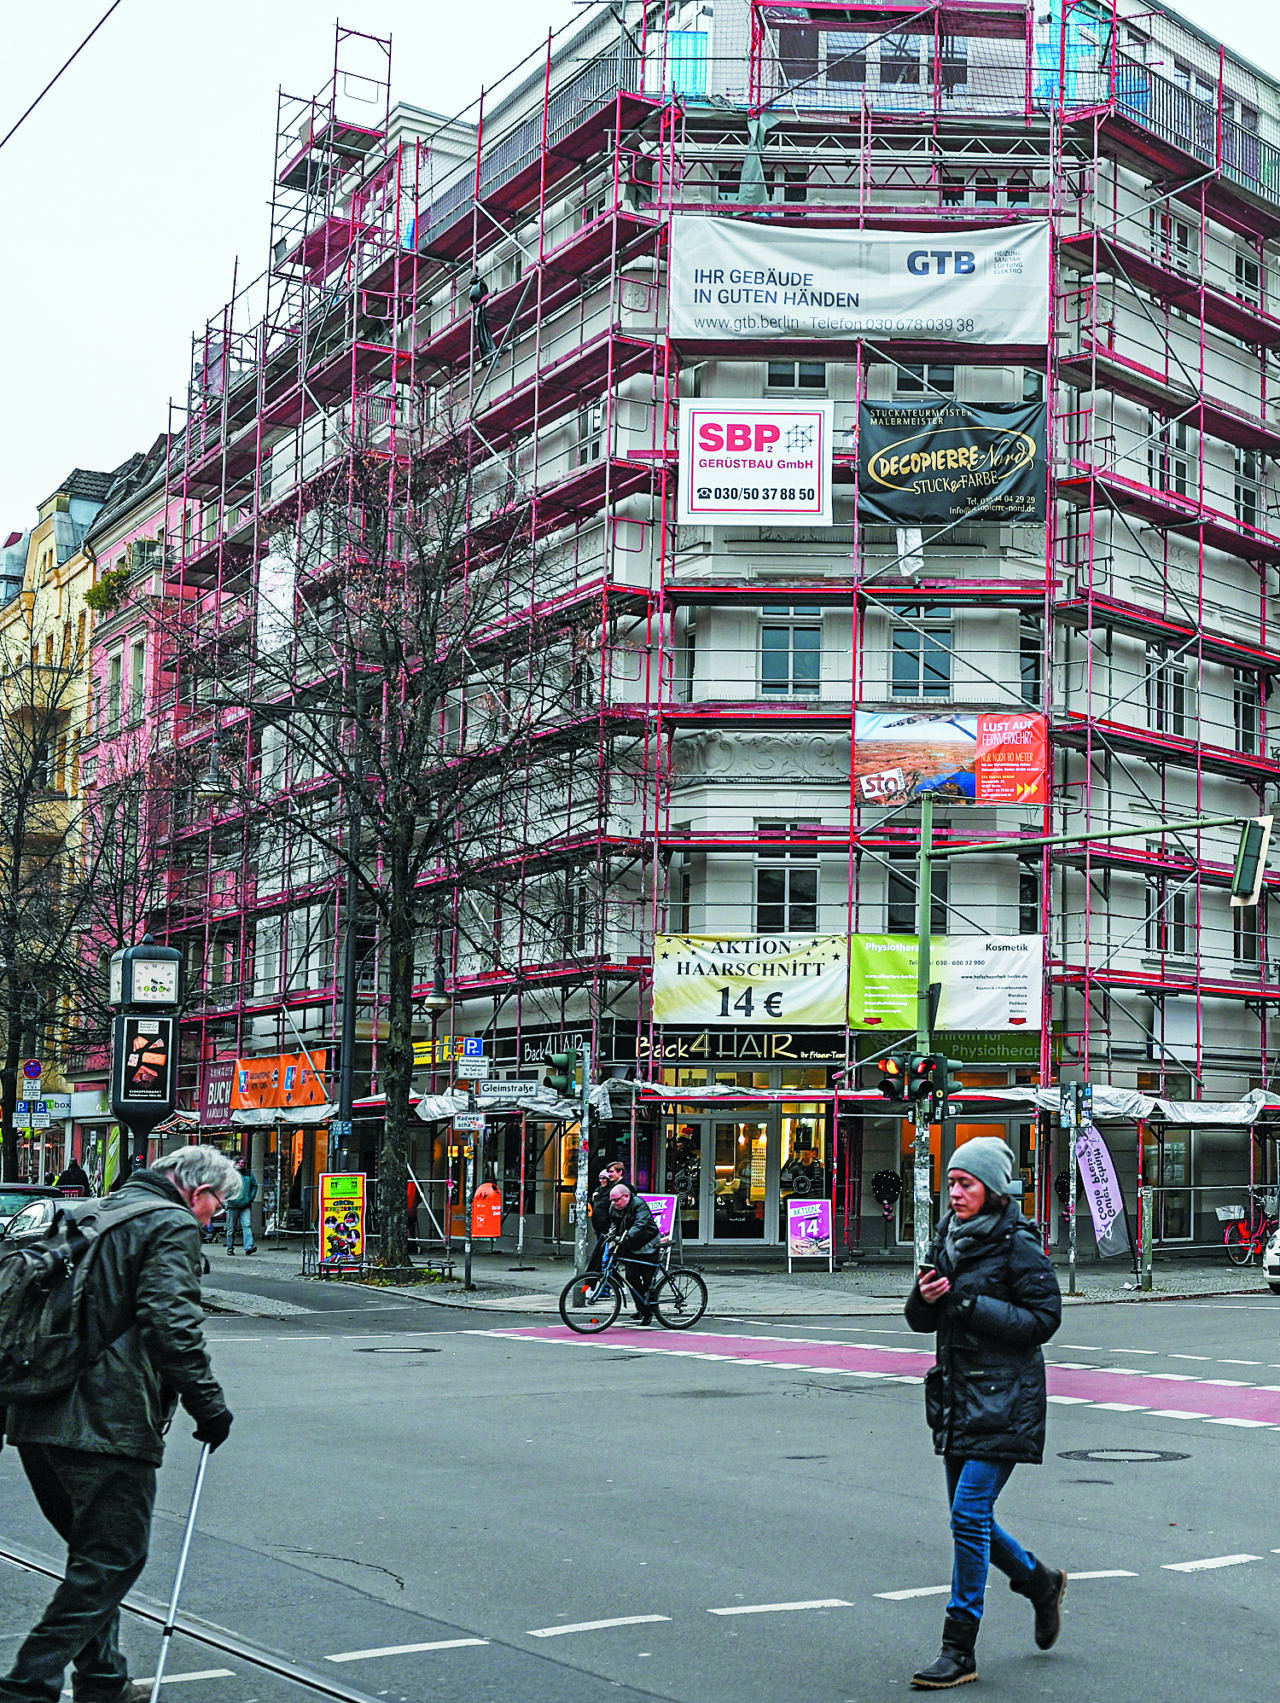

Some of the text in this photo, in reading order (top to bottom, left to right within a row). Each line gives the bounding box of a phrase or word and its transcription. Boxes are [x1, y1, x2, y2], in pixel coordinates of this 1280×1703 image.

[907, 250, 976, 276] GTB
[694, 268, 814, 287] IHR GEBÄUDE
[694, 288, 859, 308] IN GUTEN HÄNDEN
[694, 315, 974, 332] www.gtb.berlin Telefon 030 678 039 38
[870, 408, 973, 417] STUCKATEURMEISTER
[870, 417, 944, 426] MALERMEISTER
[698, 422, 780, 452] SBP
[698, 457, 813, 469] GERÜSTBAU GmbH
[714, 488, 815, 501] 030/50 37 88 50
[983, 720, 1034, 732] LUST AUF
[983, 731, 1033, 746] FERNVERKEHR?
[981, 753, 991, 762] NUR
[993, 752, 1006, 762] NOCH
[1015, 752, 1034, 762] METER
[985, 943, 1029, 952] Kosmetik
[716, 986, 783, 1018] 14 €
[467, 1040, 477, 1054] P
[952, 1044, 1056, 1058] Physiotherape
[208, 1081, 232, 1105] BUCH
[482, 1083, 534, 1093] Gleimstraße
[18, 1102, 24, 1112] P
[37, 1102, 43, 1112] P
[793, 1205, 818, 1215] AKTION
[798, 1219, 819, 1238] 14
